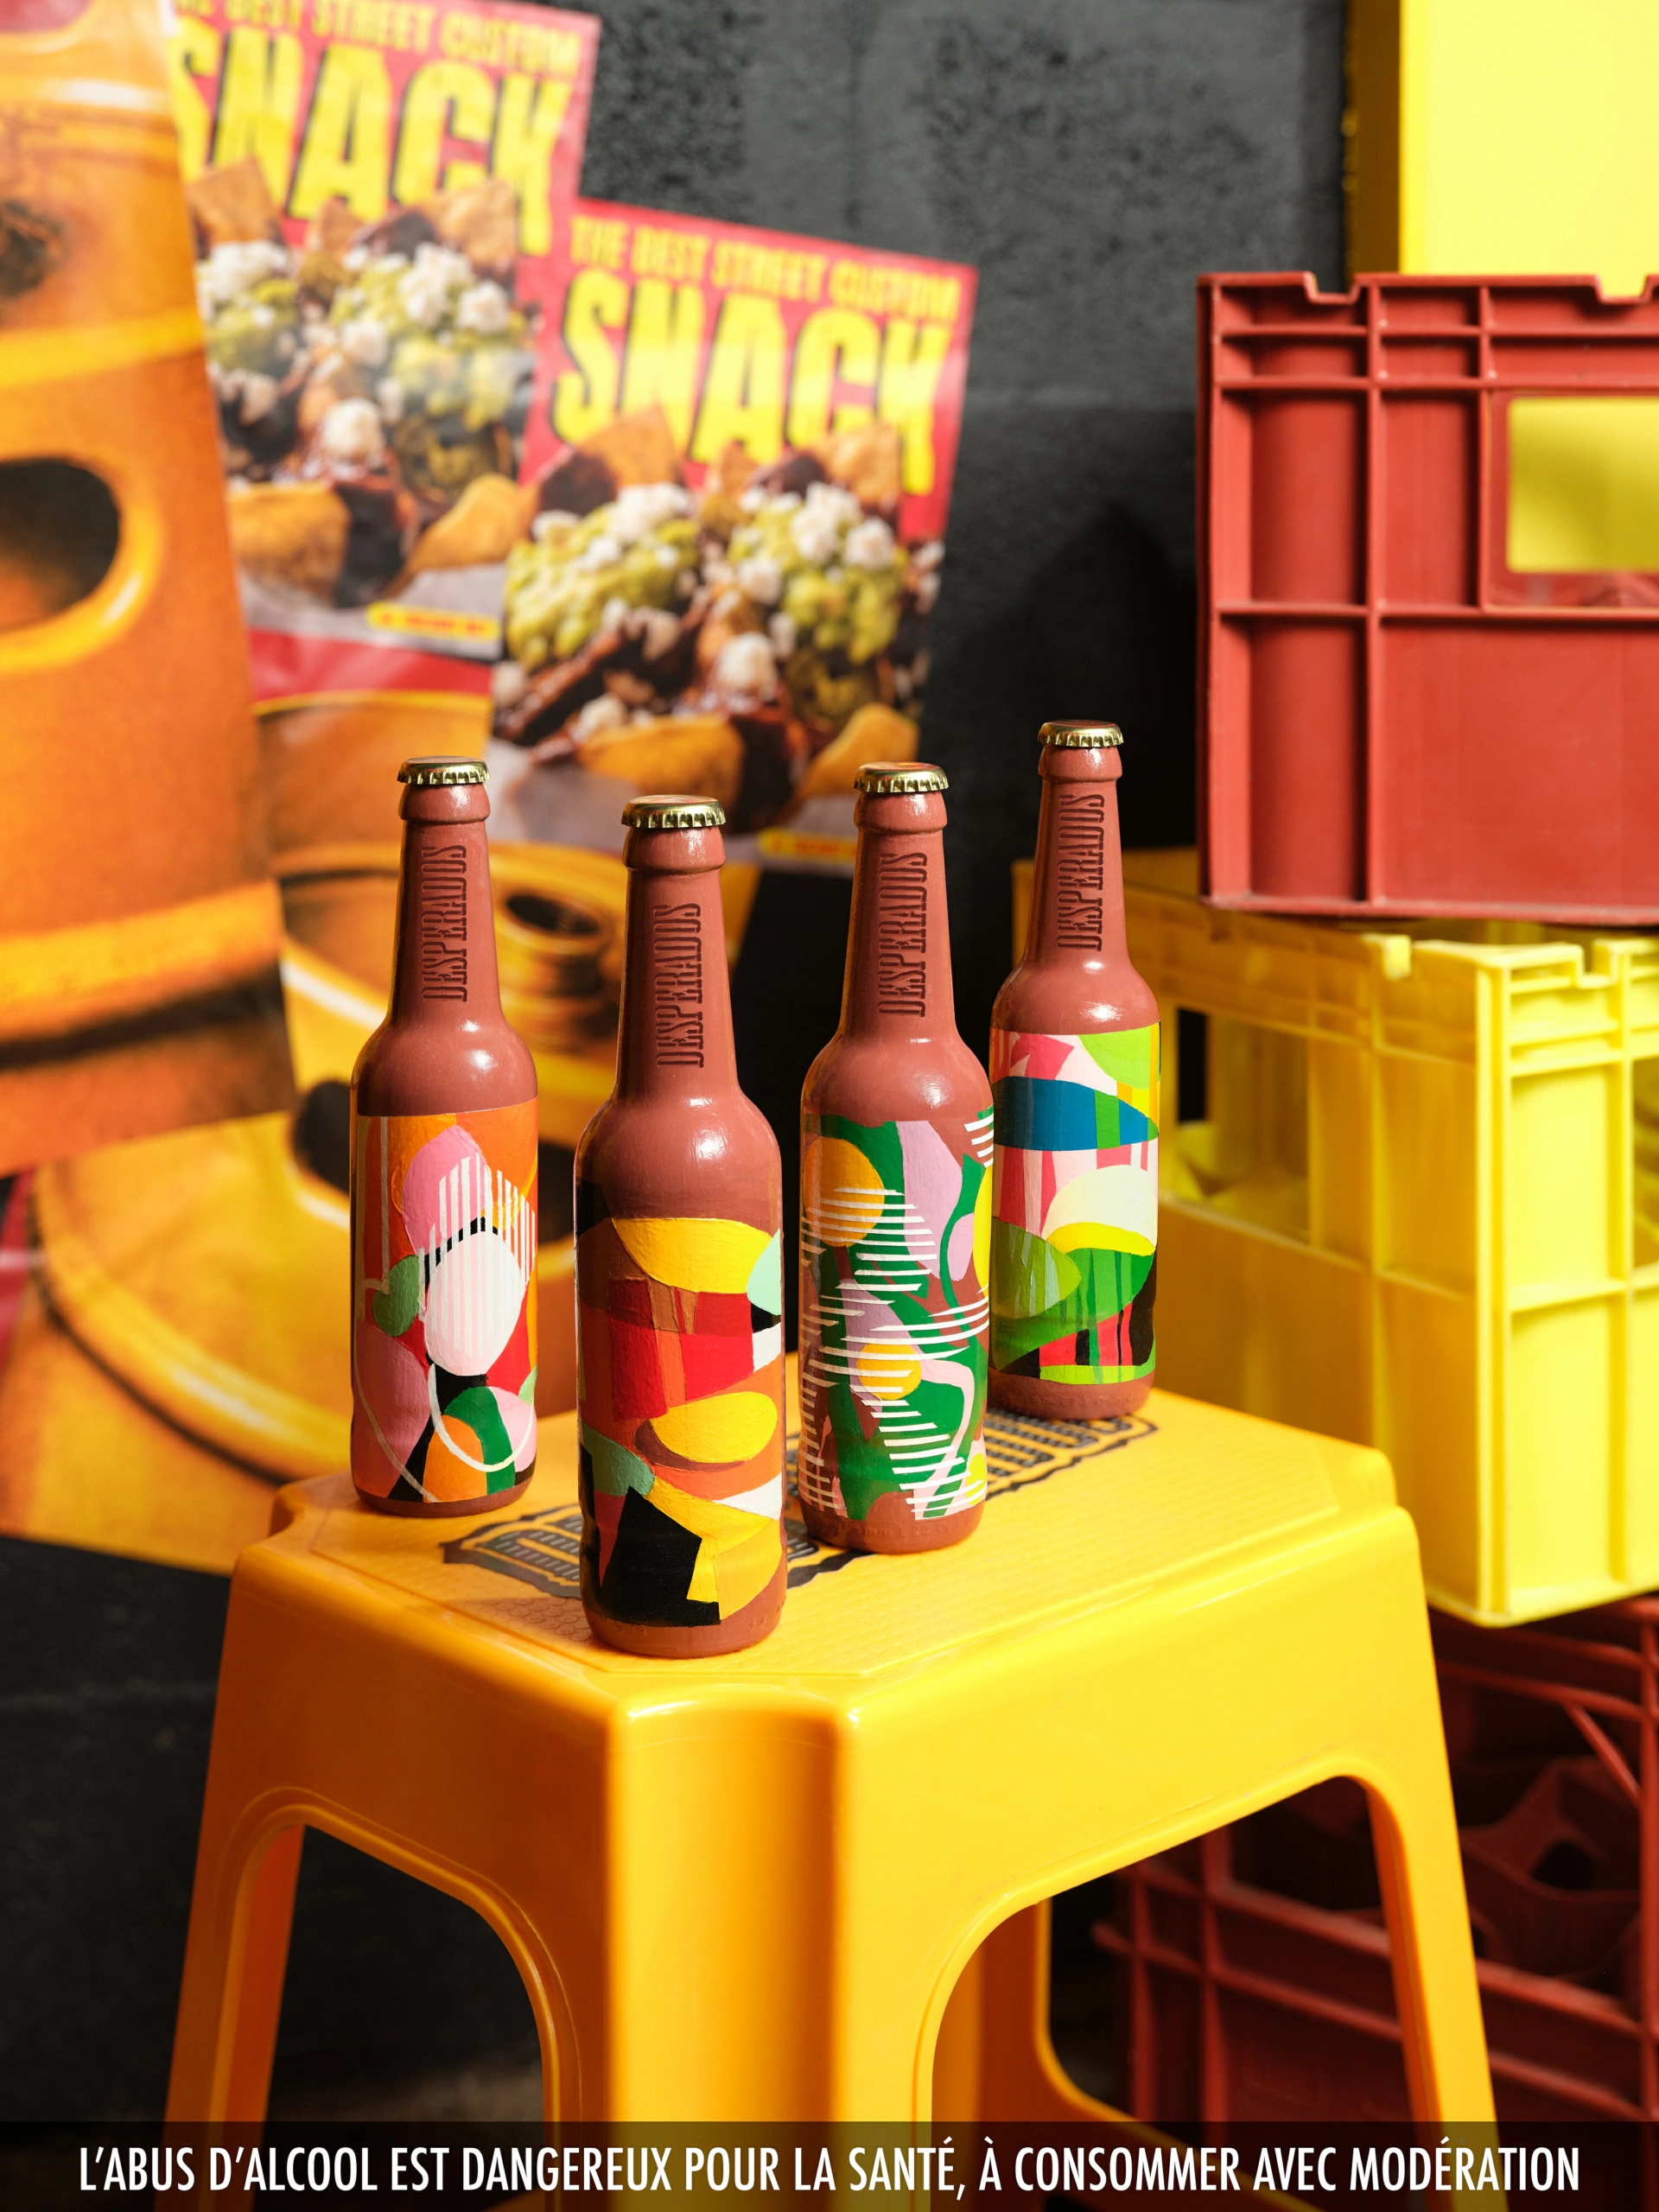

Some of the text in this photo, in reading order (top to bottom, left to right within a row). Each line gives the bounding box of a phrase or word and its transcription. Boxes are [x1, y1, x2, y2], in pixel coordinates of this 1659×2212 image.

[311, 0, 436, 54] STREET
[168, 15, 573, 257] SNACK
[569, 214, 629, 271] THE
[631, 225, 710, 282] BEST
[710, 239, 830, 303] STREET
[553, 268, 951, 496] SNACK
[421, 844, 467, 1003] DESPERADOS
[877, 852, 928, 1018] DESPERADOS
[1056, 793, 1105, 951] DESPERADOS
[652, 902, 704, 1069] DESPERADOS
